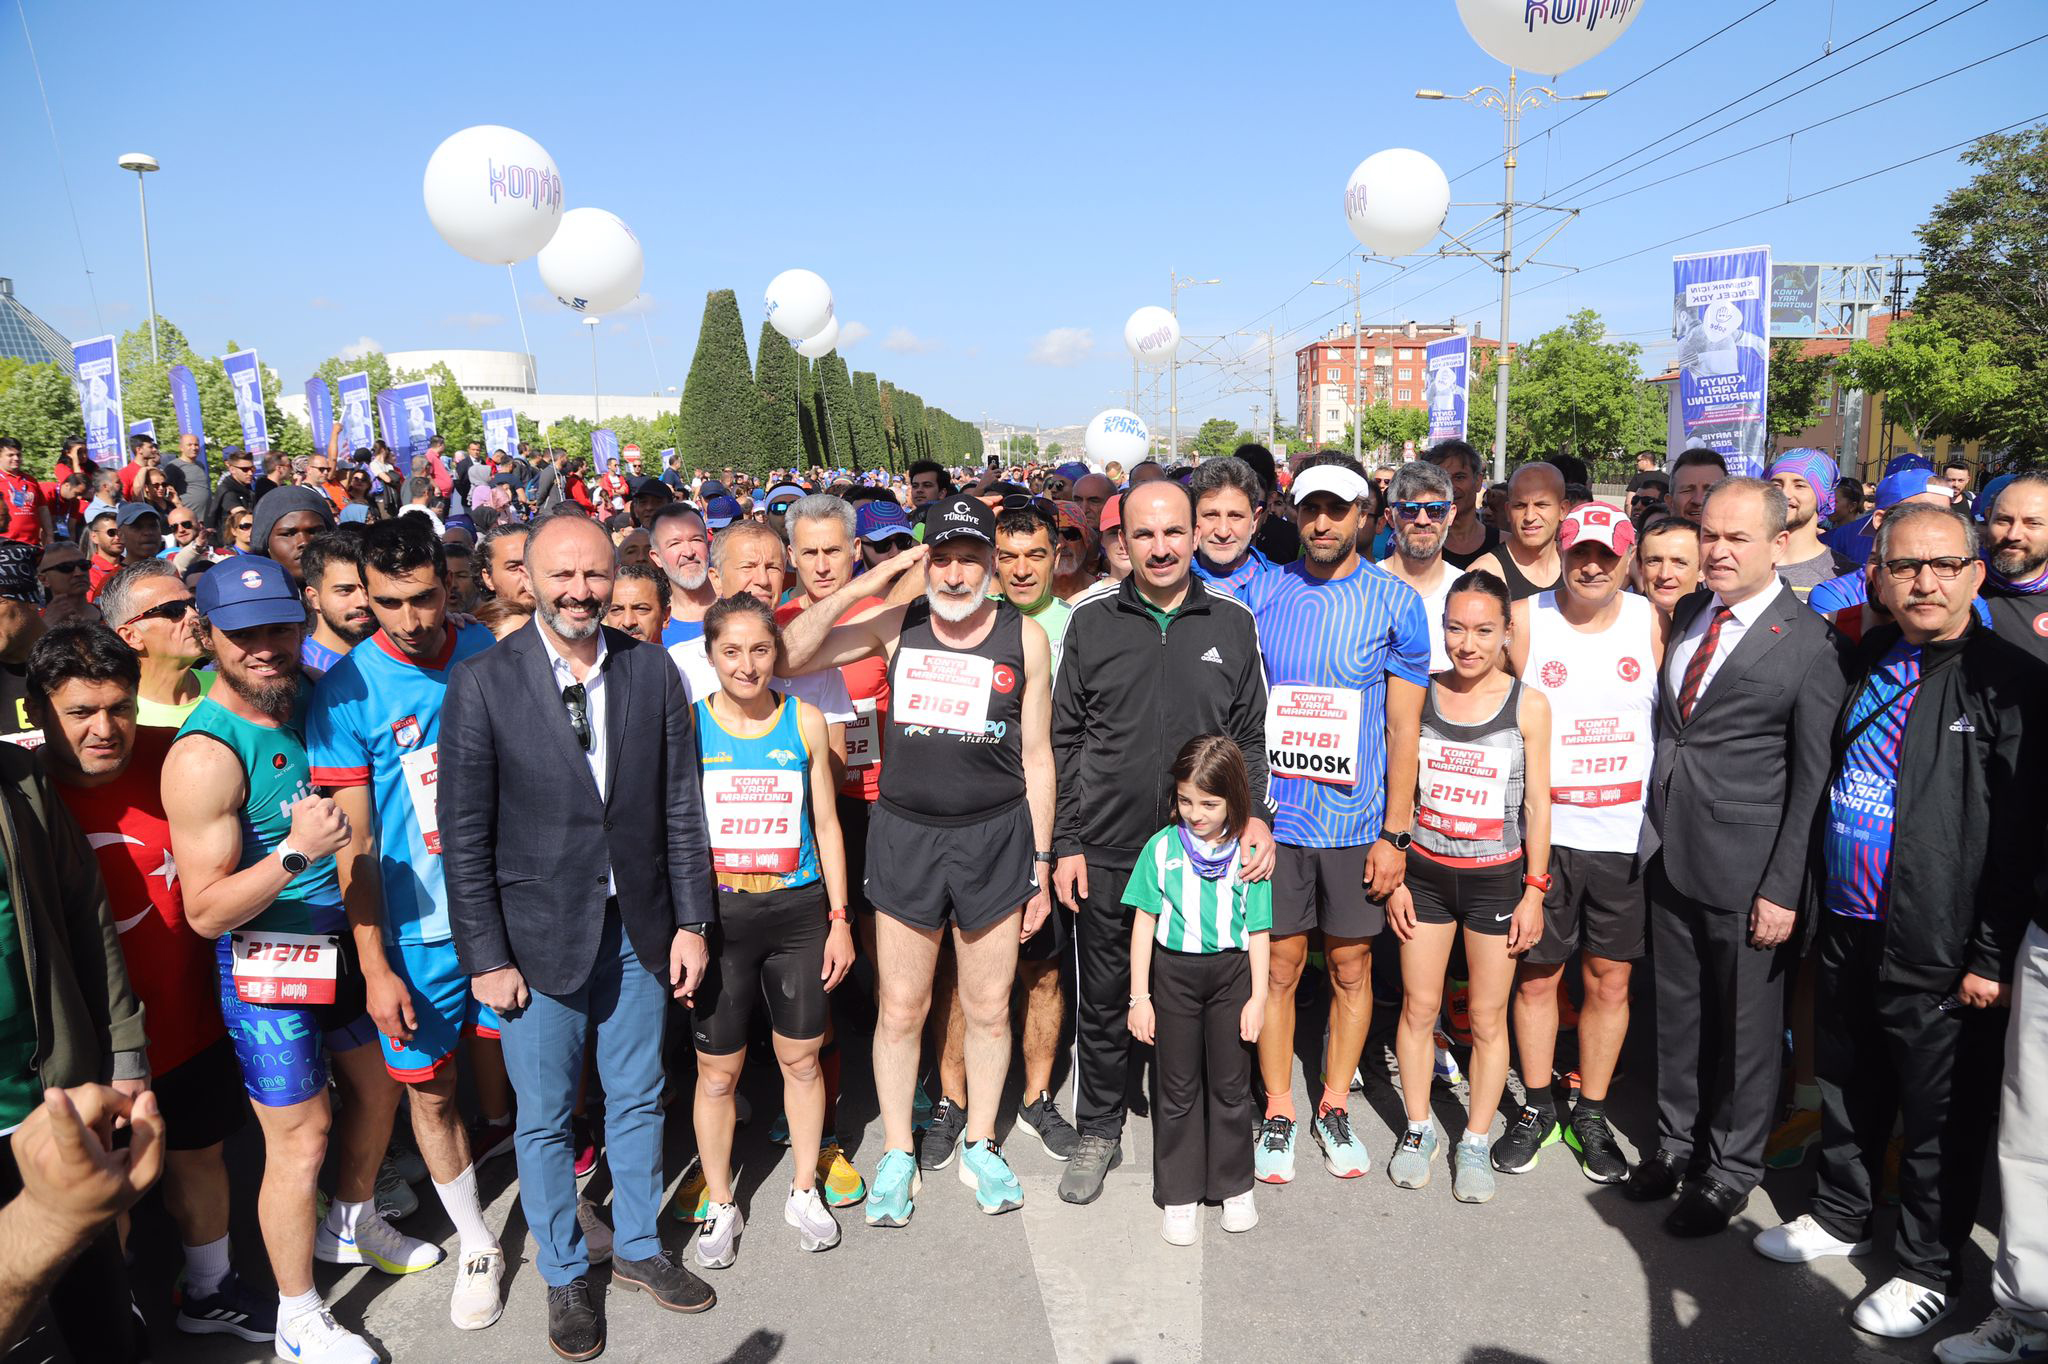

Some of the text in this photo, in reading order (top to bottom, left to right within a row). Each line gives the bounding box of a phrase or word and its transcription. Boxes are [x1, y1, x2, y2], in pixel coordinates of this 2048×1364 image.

[1773, 288, 1804, 296] KONYA
[1770, 301, 1814, 309] ARATONU
[943, 512, 980, 525] TÜRKİYE
[1200, 655, 1223, 664] adidas
[1294, 693, 1332, 702] KONYA
[908, 693, 970, 717] 21169
[1299, 701, 1326, 710] YARI
[1279, 707, 1345, 719] MARATONU
[1577, 719, 1617, 729] KONYA
[1584, 727, 1613, 736] YARI
[20, 737, 47, 748] KON
[959, 735, 1001, 744] ATLETİZM
[1281, 730, 1341, 749] 21481
[1565, 732, 1631, 744] MARATONU
[1443, 748, 1483, 759] KONYA
[1269, 749, 1351, 775] KUDOSK
[1449, 757, 1475, 767] YARI
[1570, 755, 1628, 775] 21217
[1431, 761, 1494, 777] MARATONU
[735, 777, 776, 785] KONYA
[741, 785, 769, 793] YARI
[1430, 783, 1489, 806] 21541
[1846, 782, 1888, 802] YARI
[720, 793, 789, 801] MARATONU
[1829, 785, 1895, 819] MARATO
[720, 818, 788, 834] 21075
[246, 942, 321, 963] 21276
[240, 1013, 311, 1047] ME
[252, 1050, 297, 1068] me
